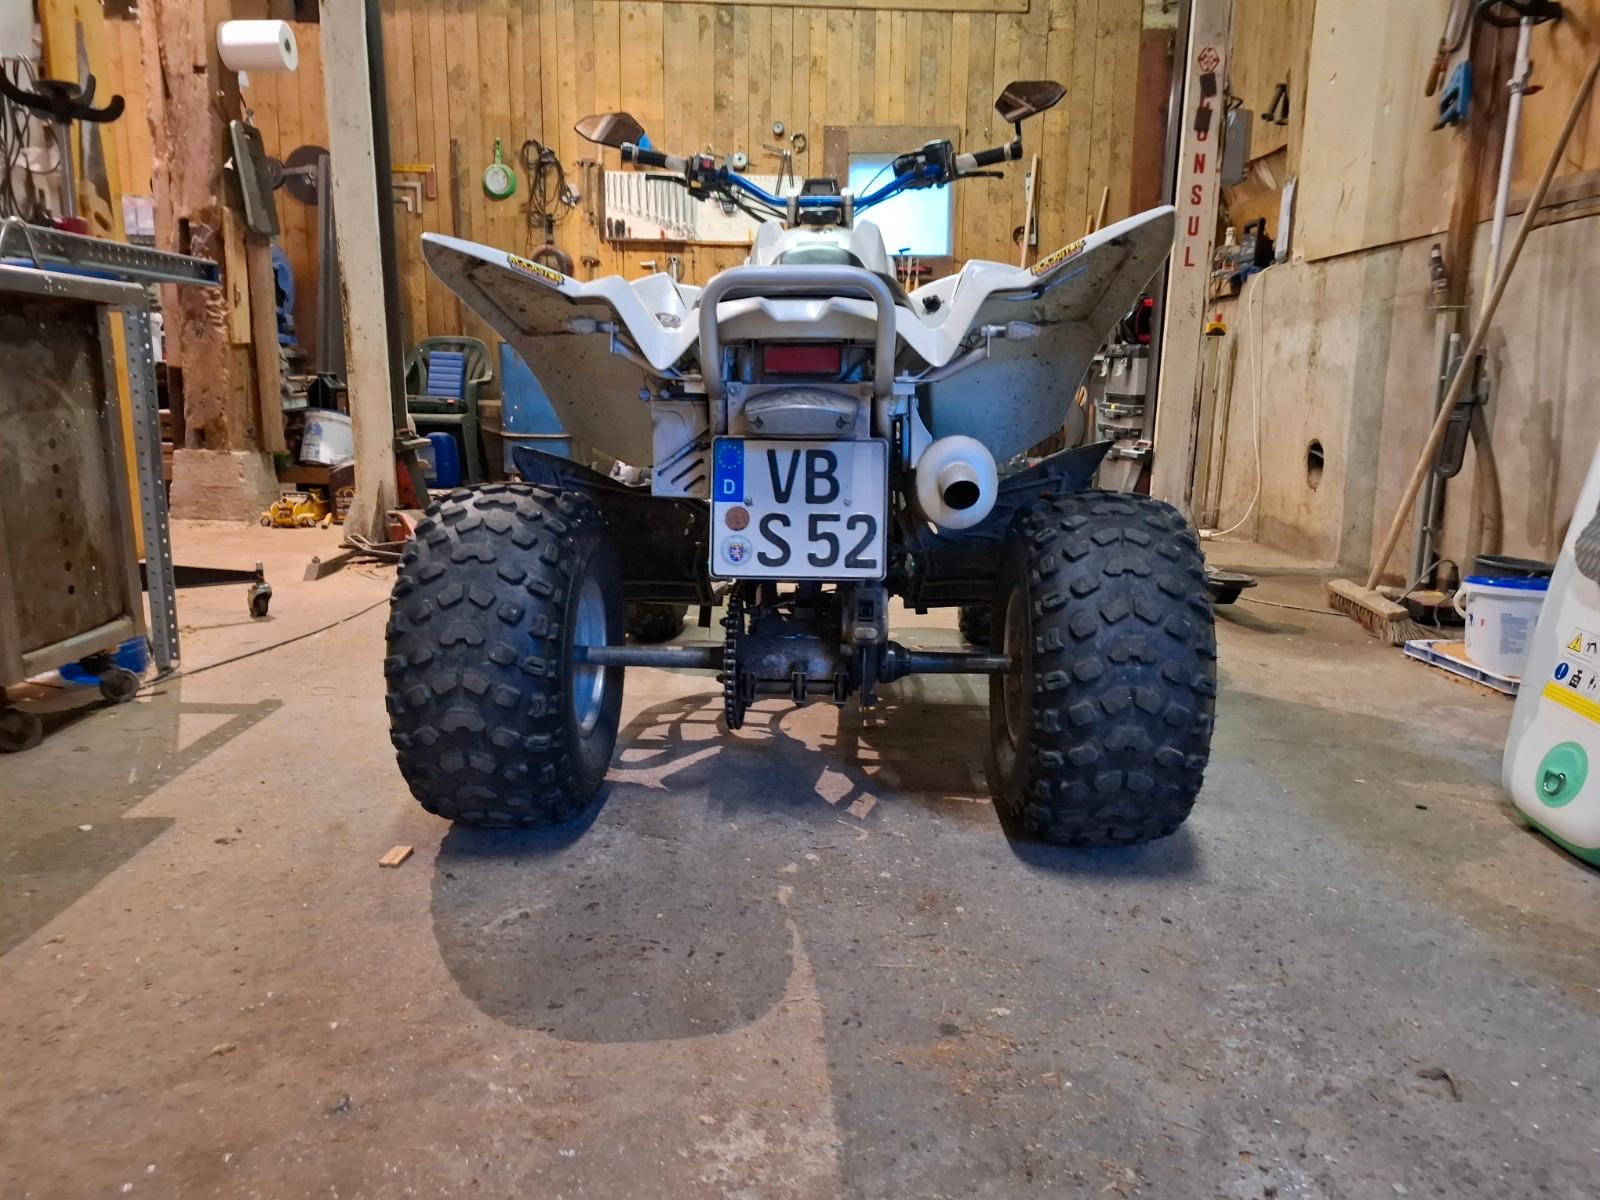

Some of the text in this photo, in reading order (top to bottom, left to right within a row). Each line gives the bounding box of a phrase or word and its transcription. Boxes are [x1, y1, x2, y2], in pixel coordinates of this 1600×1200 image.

[723, 479, 735, 495] D
[766, 449, 840, 504] VB
[757, 513, 877, 569] S 52
